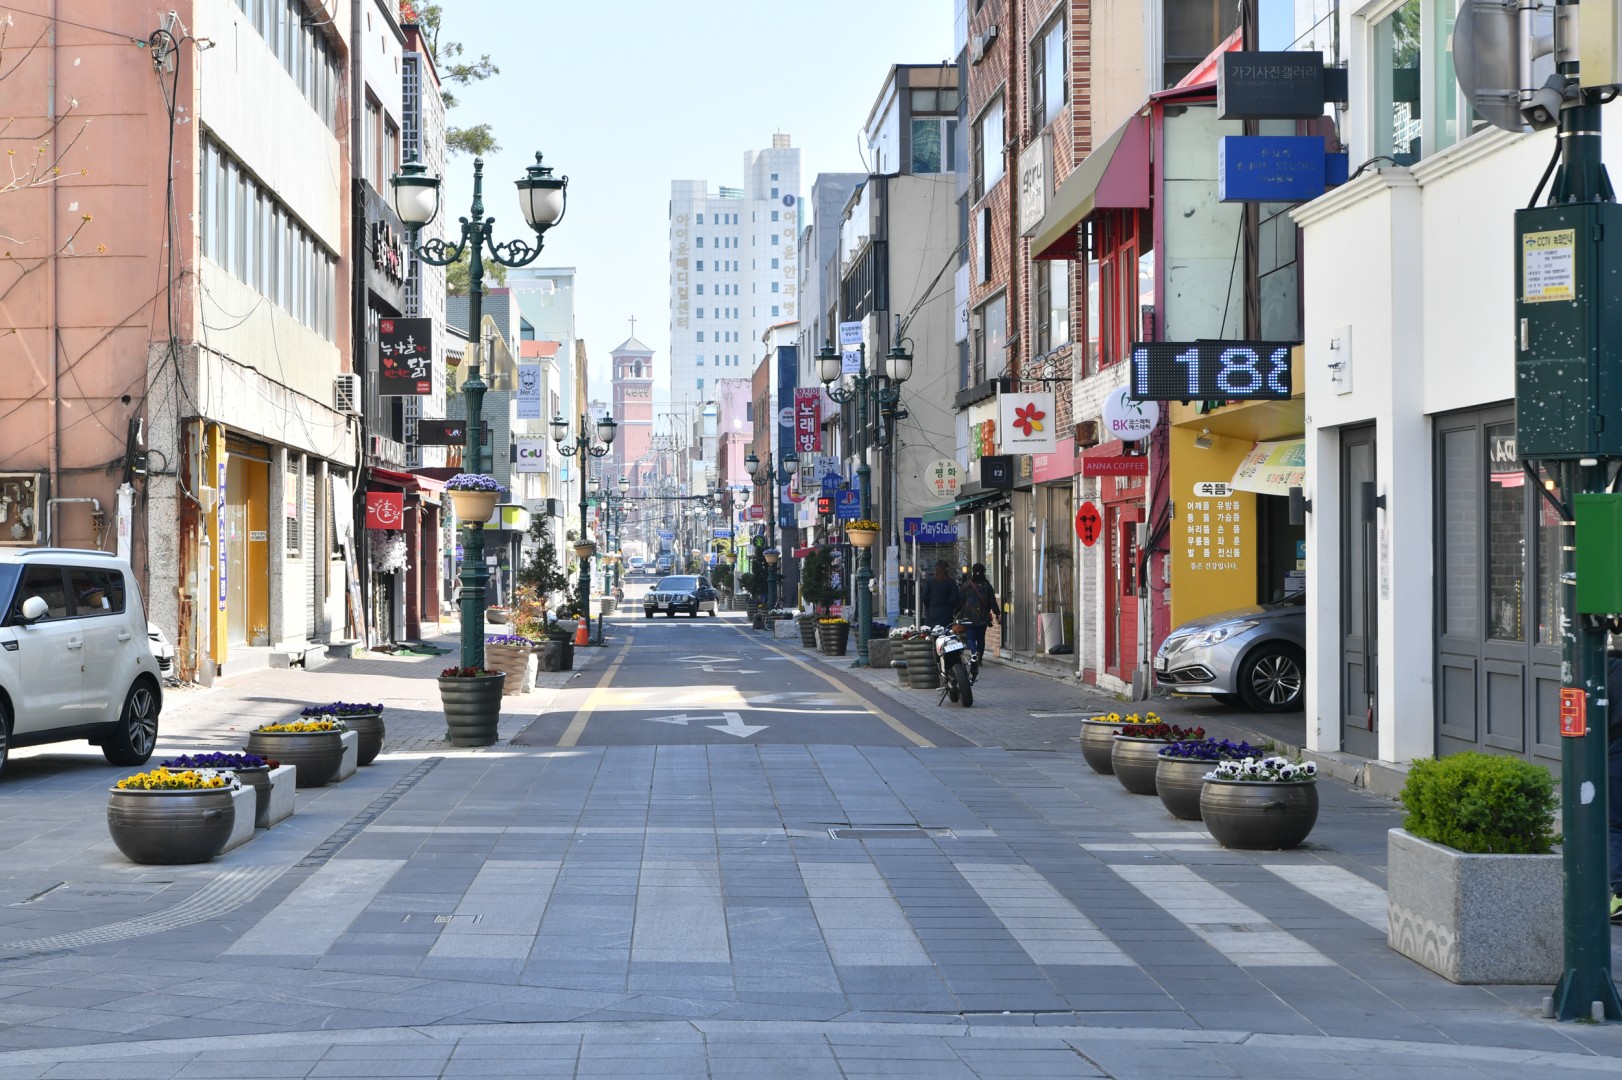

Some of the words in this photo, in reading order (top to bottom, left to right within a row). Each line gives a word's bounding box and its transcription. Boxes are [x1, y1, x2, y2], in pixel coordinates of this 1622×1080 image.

[1232, 66, 1317, 79] 가기사진갤러리
[1537, 236, 1551, 247] CCTV
[1553, 232, 1573, 245] 녹화안내
[676, 213, 690, 330] 아이윤메디컬센터
[799, 402, 815, 452] 노래방
[1113, 419, 1129, 431] BK
[1087, 462, 1112, 470] ANNA
[1113, 462, 1145, 470] COFFEE
[935, 468, 957, 478] 평화
[934, 479, 957, 489] 쌈밥
[1202, 484, 1226, 495] 쑥뜸
[1187, 501, 1210, 511] 어깨뜸
[1217, 501, 1240, 511] 유방뜸
[1217, 513, 1240, 523] 가슴뜸
[920, 522, 958, 538] PlayStatio
[1187, 525, 1210, 534] 허리뜸
[1187, 536, 1210, 546] 무릎뜸
[1217, 548, 1240, 558] 전신뜸
[1191, 562, 1203, 570] 뜸은
[1205, 562, 1239, 571] 건강입니다.
